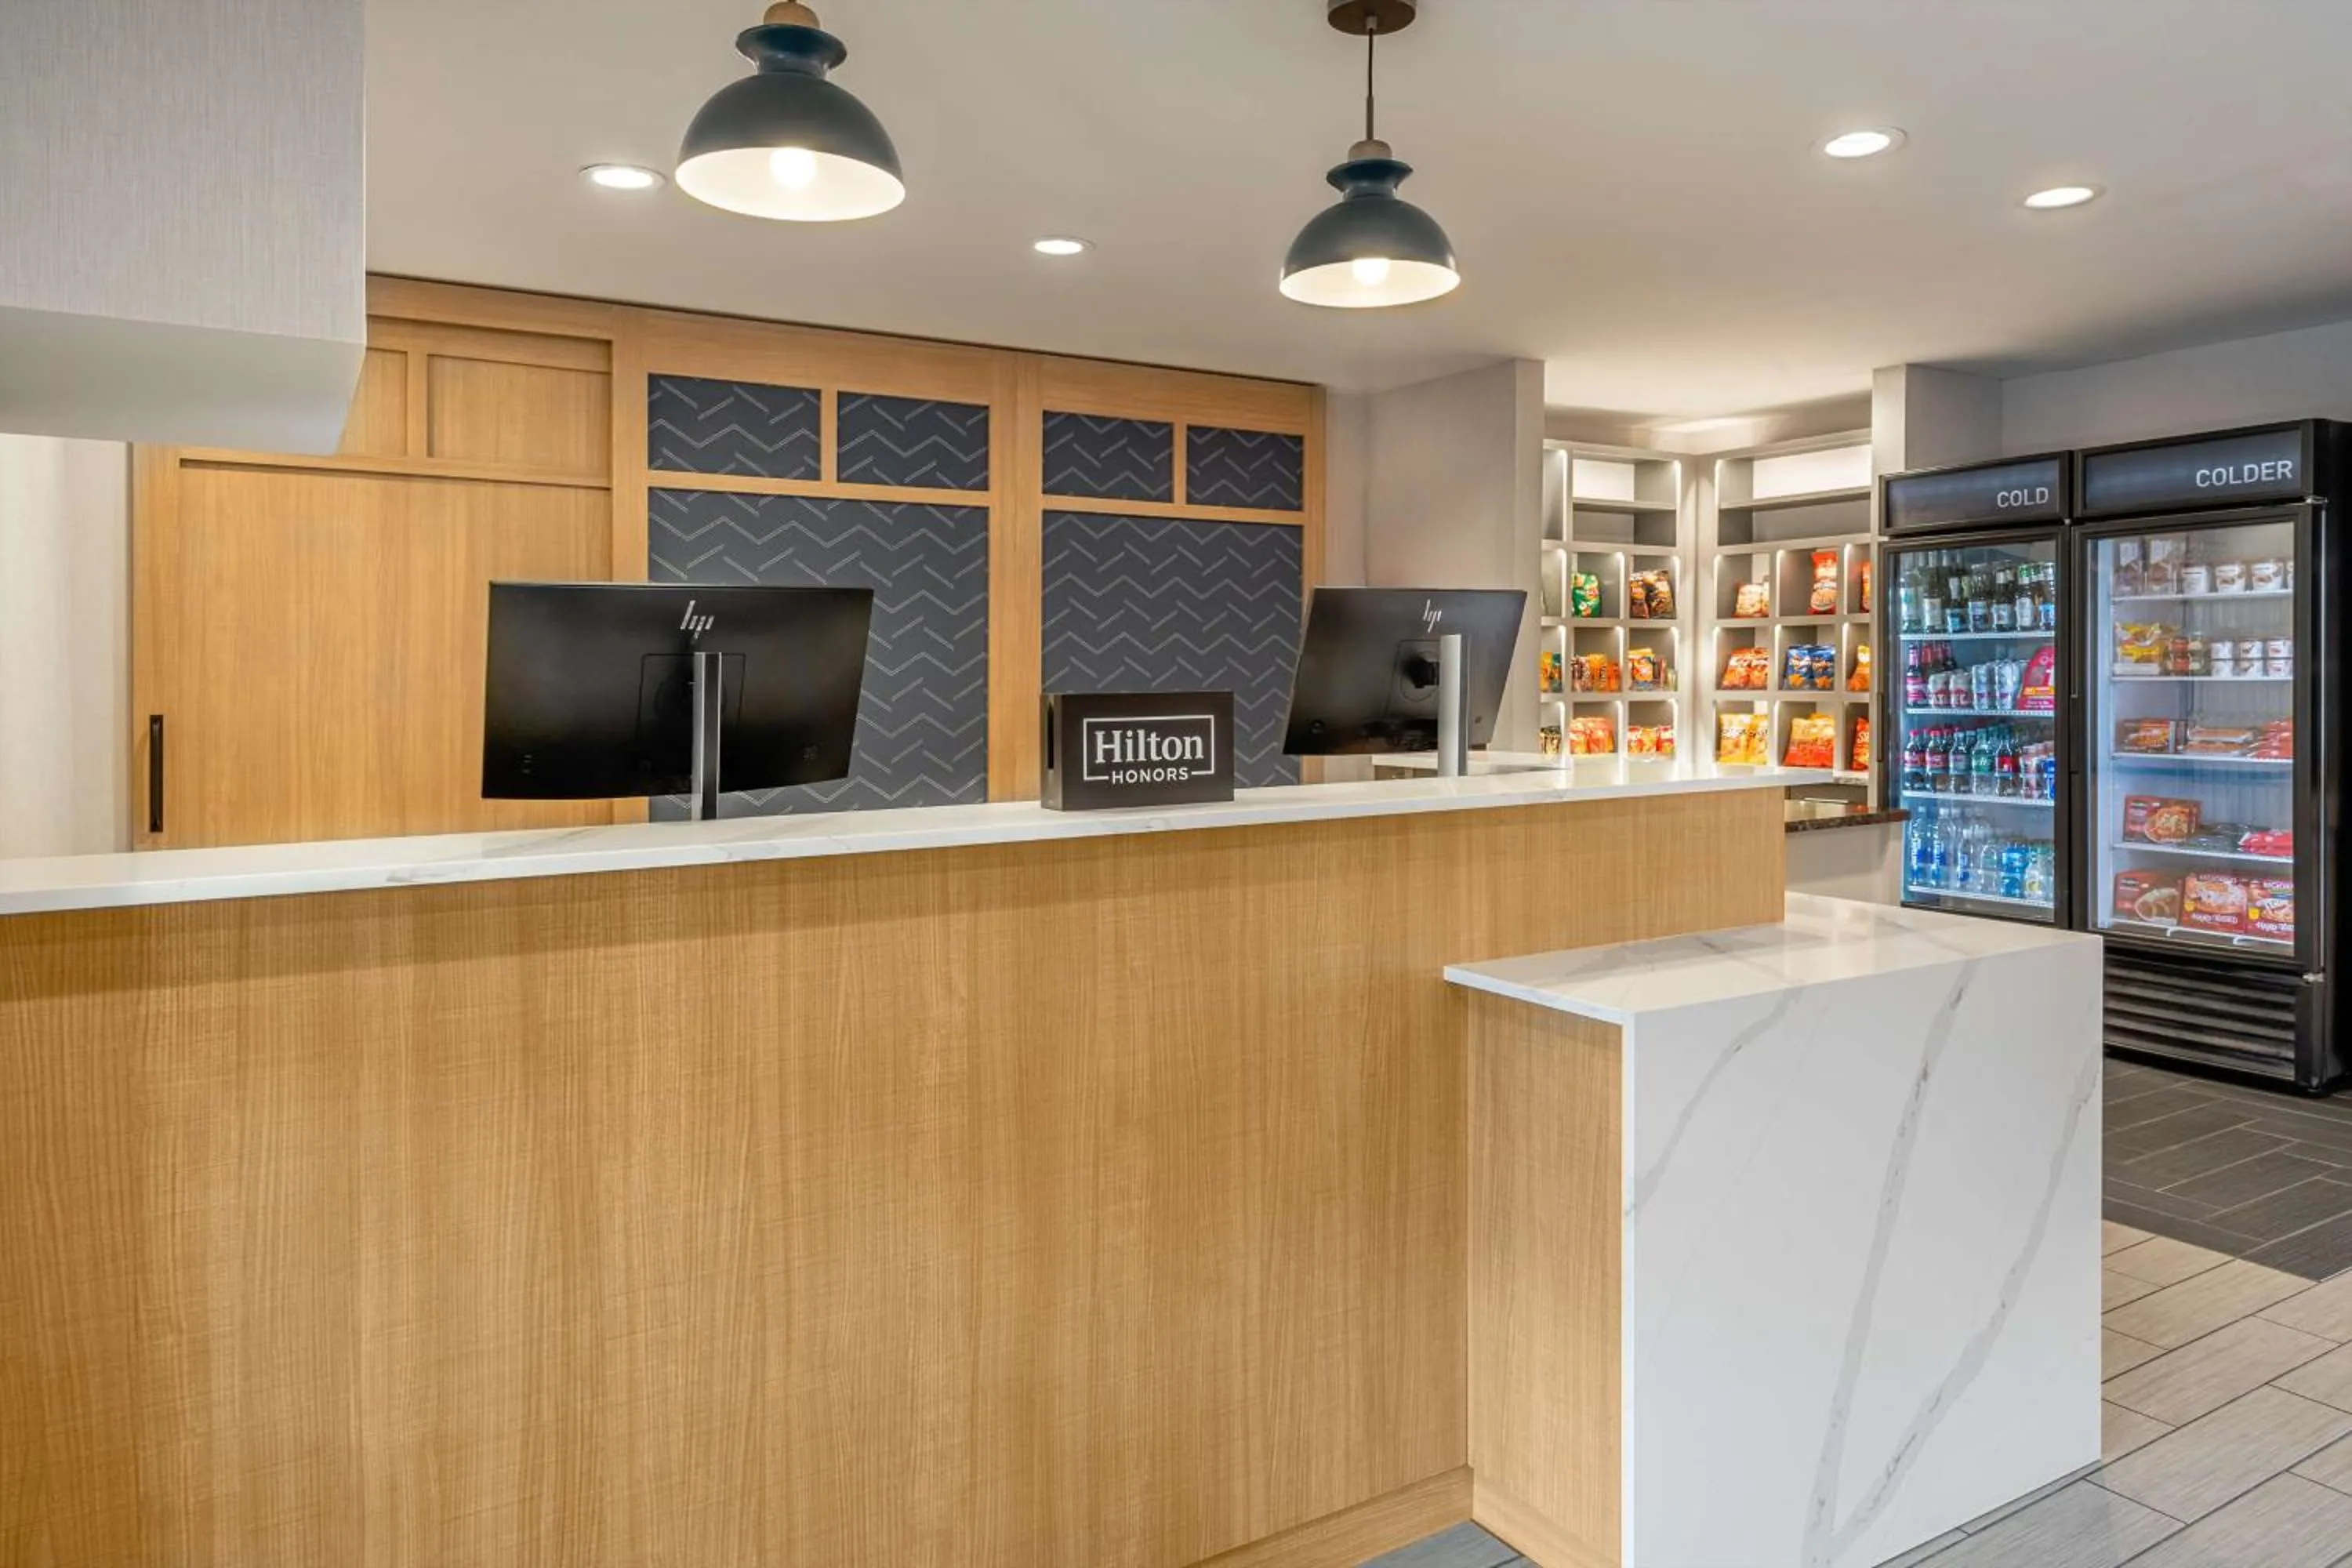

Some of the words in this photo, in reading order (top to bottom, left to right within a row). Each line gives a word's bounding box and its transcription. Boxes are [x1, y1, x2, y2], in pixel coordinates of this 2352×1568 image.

[2196, 460, 2292, 487] COLDER
[1997, 487, 2049, 507] COLD
[680, 600, 715, 640] hp
[1423, 599, 1442, 633] hp
[1094, 729, 1204, 764] Hilton
[1112, 767, 1189, 784] HONORS
